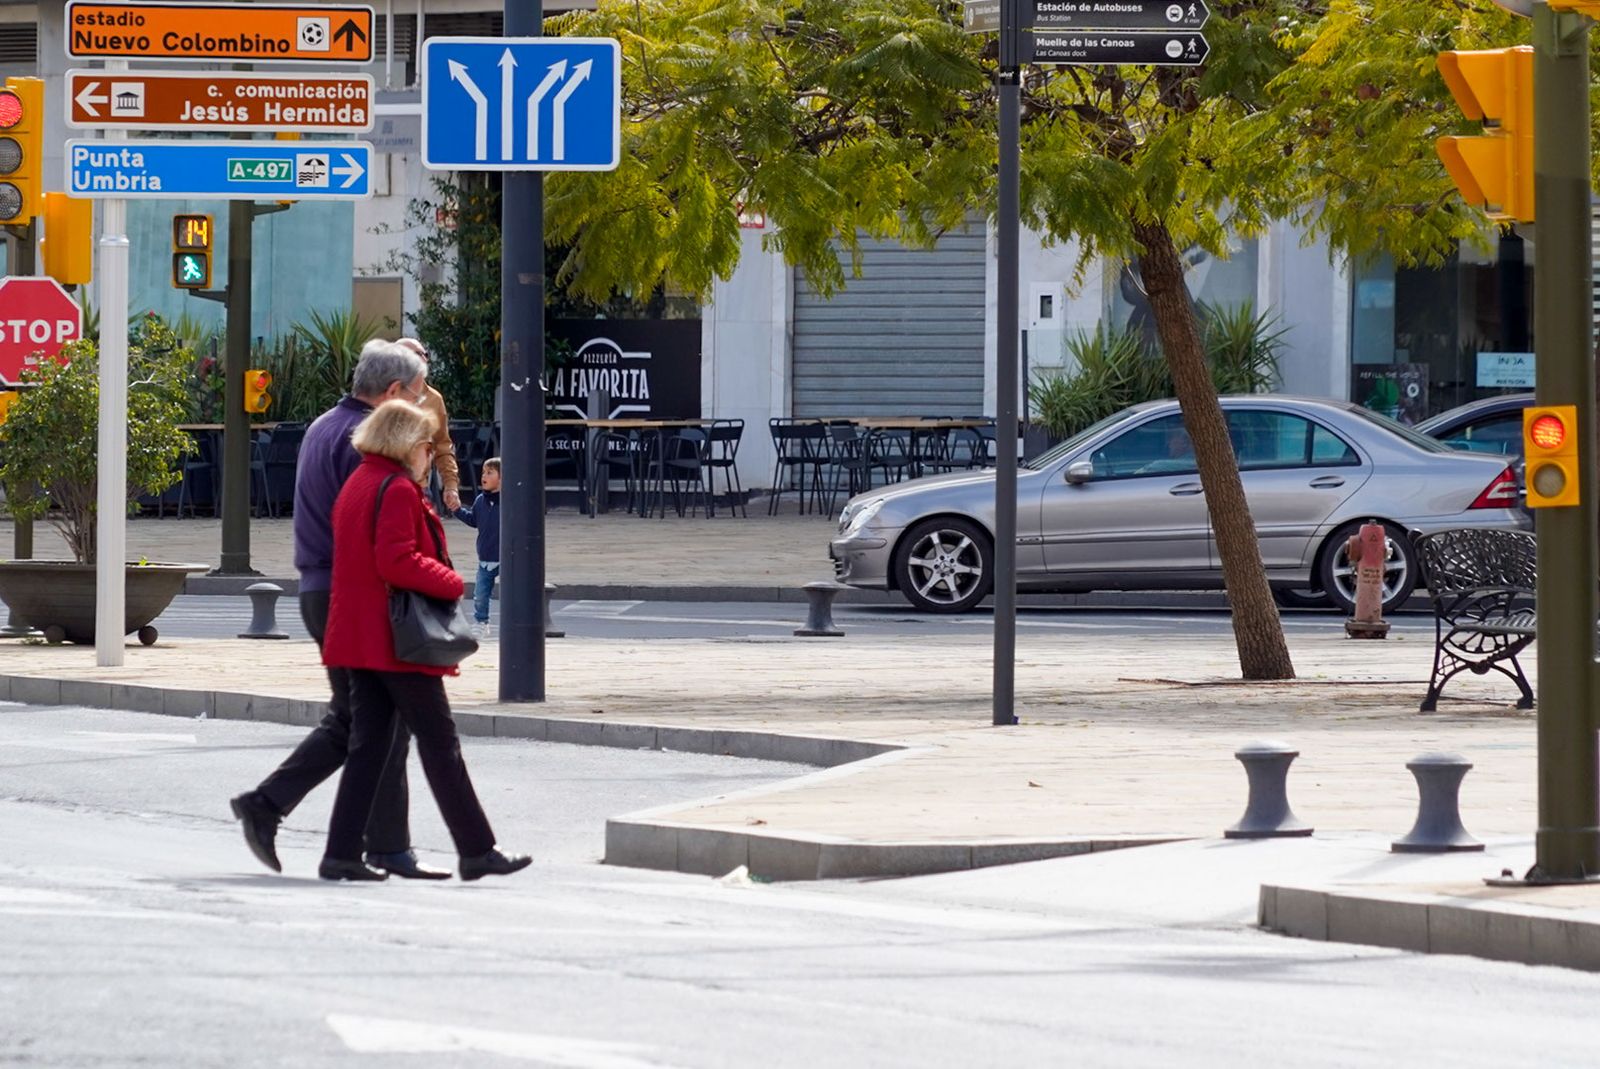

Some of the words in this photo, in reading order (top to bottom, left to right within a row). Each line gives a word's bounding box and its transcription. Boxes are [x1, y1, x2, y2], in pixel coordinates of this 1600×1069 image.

[1037, 2, 1076, 12] Estación
[1079, 3, 1091, 12] de
[1093, 3, 1143, 12] Autobuses
[75, 11, 146, 27] estadio
[1050, 14, 1072, 22] Station
[75, 31, 150, 51] Nuevo
[162, 32, 291, 53] Colombino
[1036, 38, 1068, 47] Muelle
[1070, 38, 1082, 47] de
[1084, 38, 1098, 47] las
[1101, 38, 1135, 48] Canoas
[207, 85, 223, 97] c.
[235, 83, 367, 99] comunicación
[180, 100, 249, 121] Jesús
[264, 102, 365, 123] Hermida
[74, 148, 144, 168] Punta
[232, 162, 289, 178] A-497
[74, 170, 162, 191] Umbría
[187, 219, 207, 246] 14
[583, 352, 617, 364] PIZZERÍA
[570, 368, 650, 399] FAVORITA
